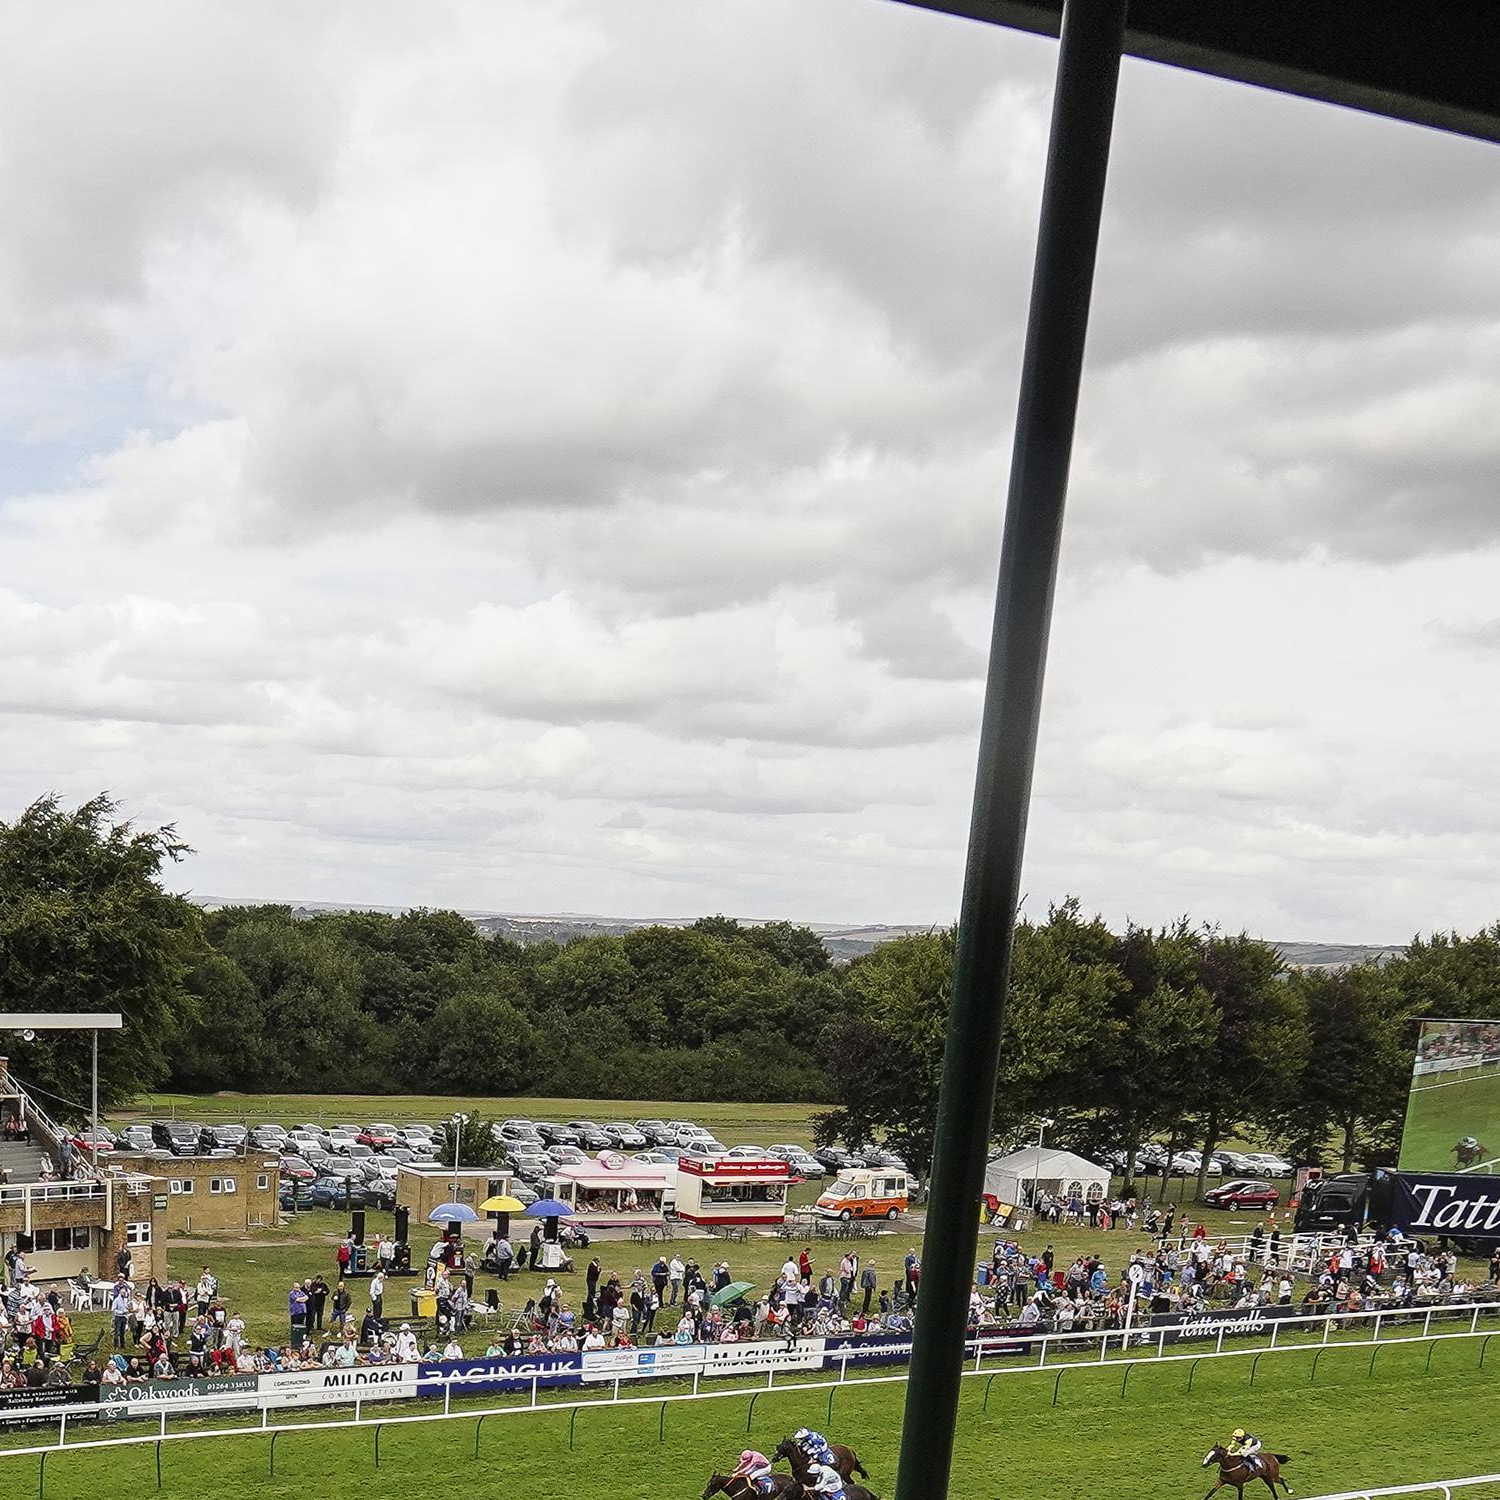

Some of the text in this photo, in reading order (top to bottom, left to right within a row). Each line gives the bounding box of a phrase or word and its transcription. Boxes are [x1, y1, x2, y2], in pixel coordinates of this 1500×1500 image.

[1178, 1310, 1265, 1338] Tattersalls
[128, 1383, 200, 1401] Oakwoods
[765, 1482, 772, 1494] 7
